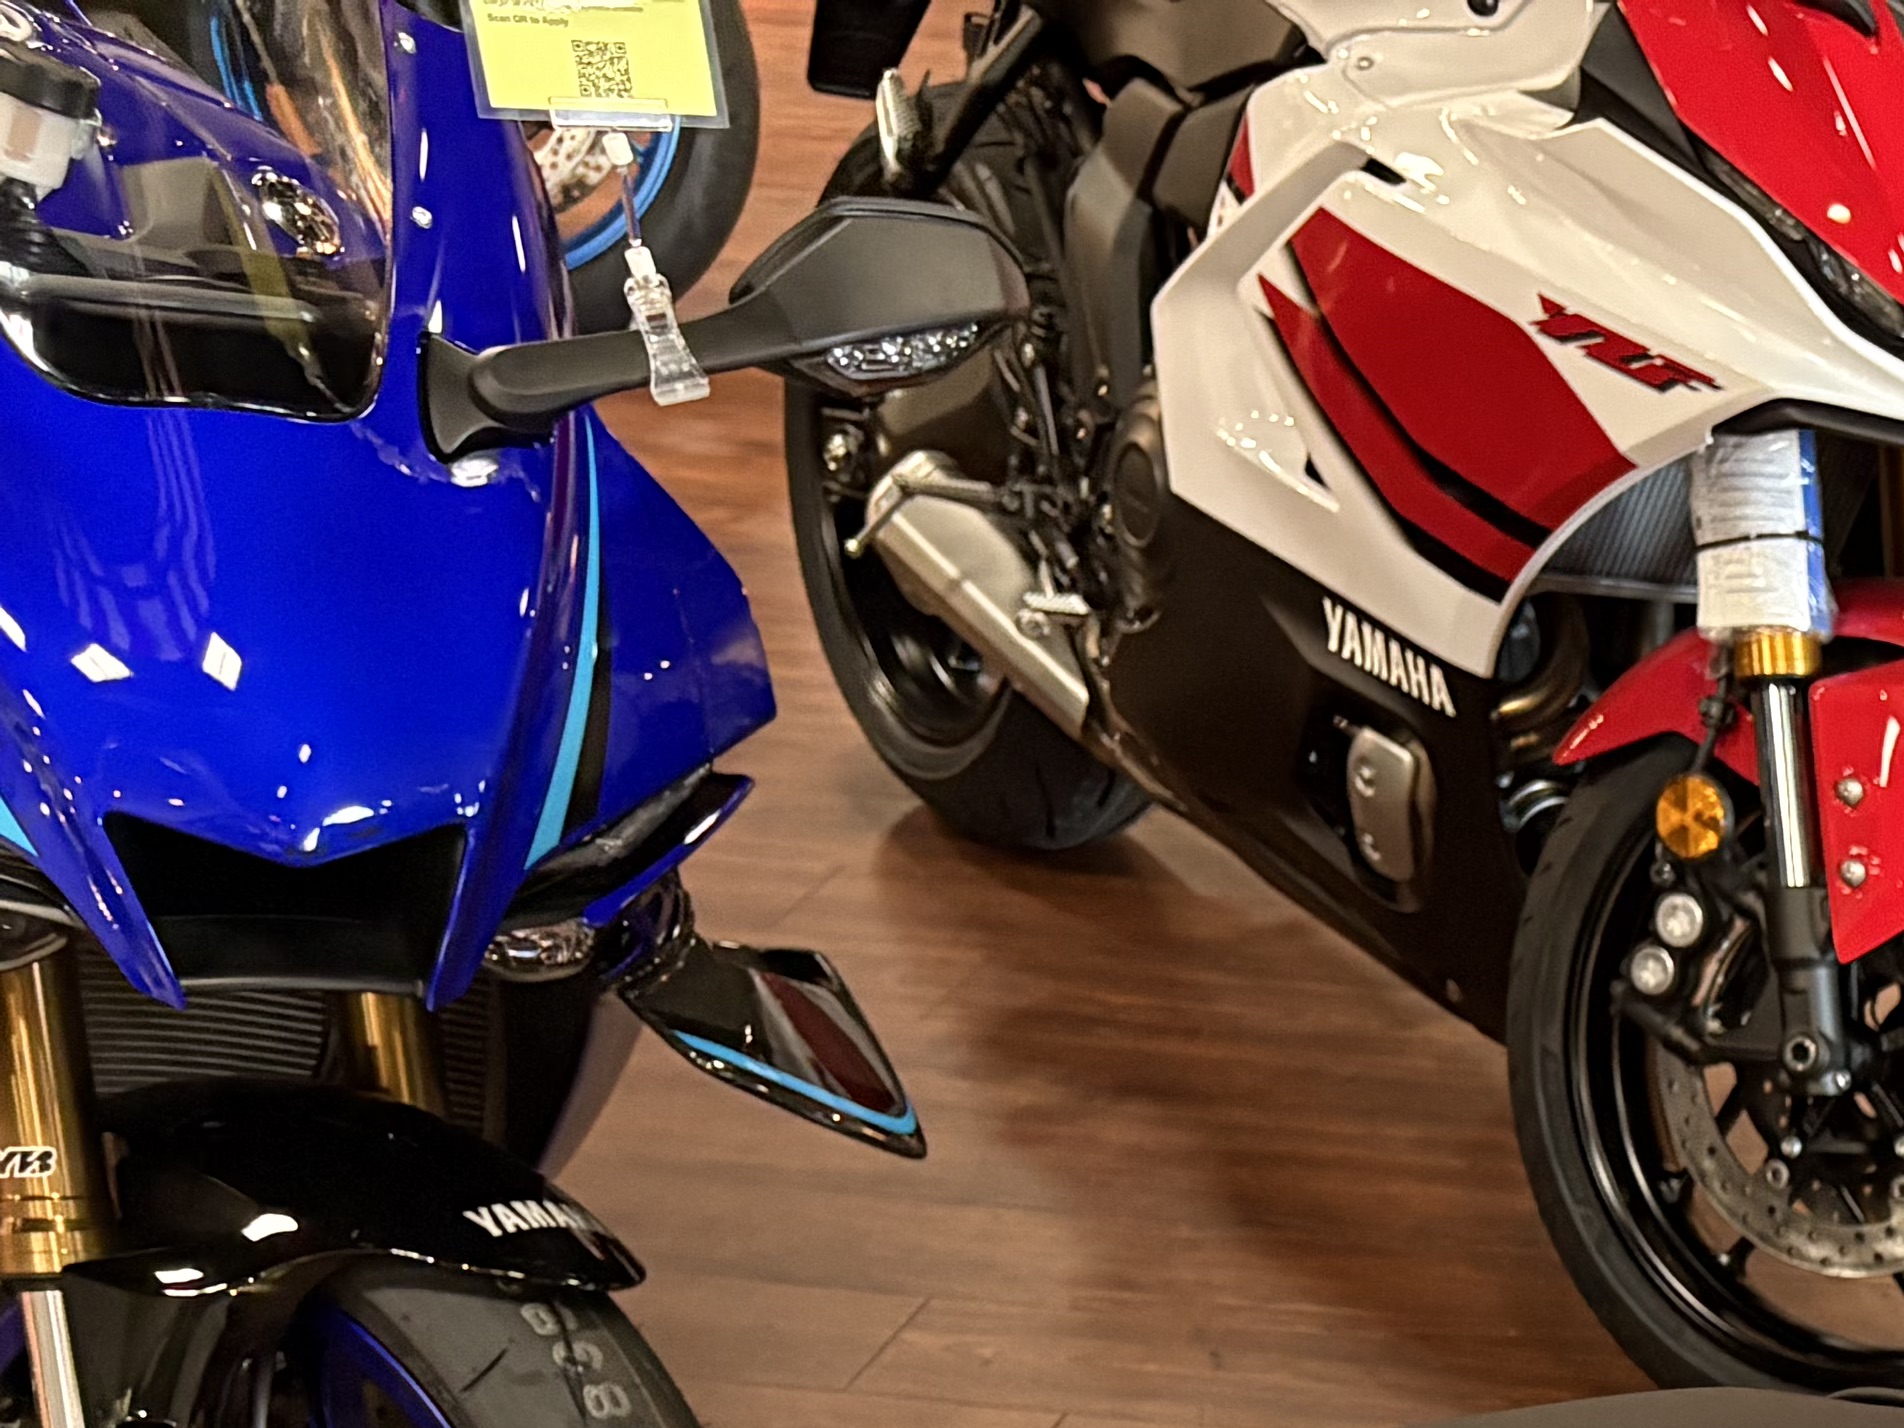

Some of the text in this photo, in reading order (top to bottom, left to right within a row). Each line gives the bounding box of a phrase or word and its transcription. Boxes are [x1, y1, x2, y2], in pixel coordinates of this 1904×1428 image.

[487, 13, 569, 28] Scan QR to Apply
[1322, 596, 1457, 718] YAMAHA
